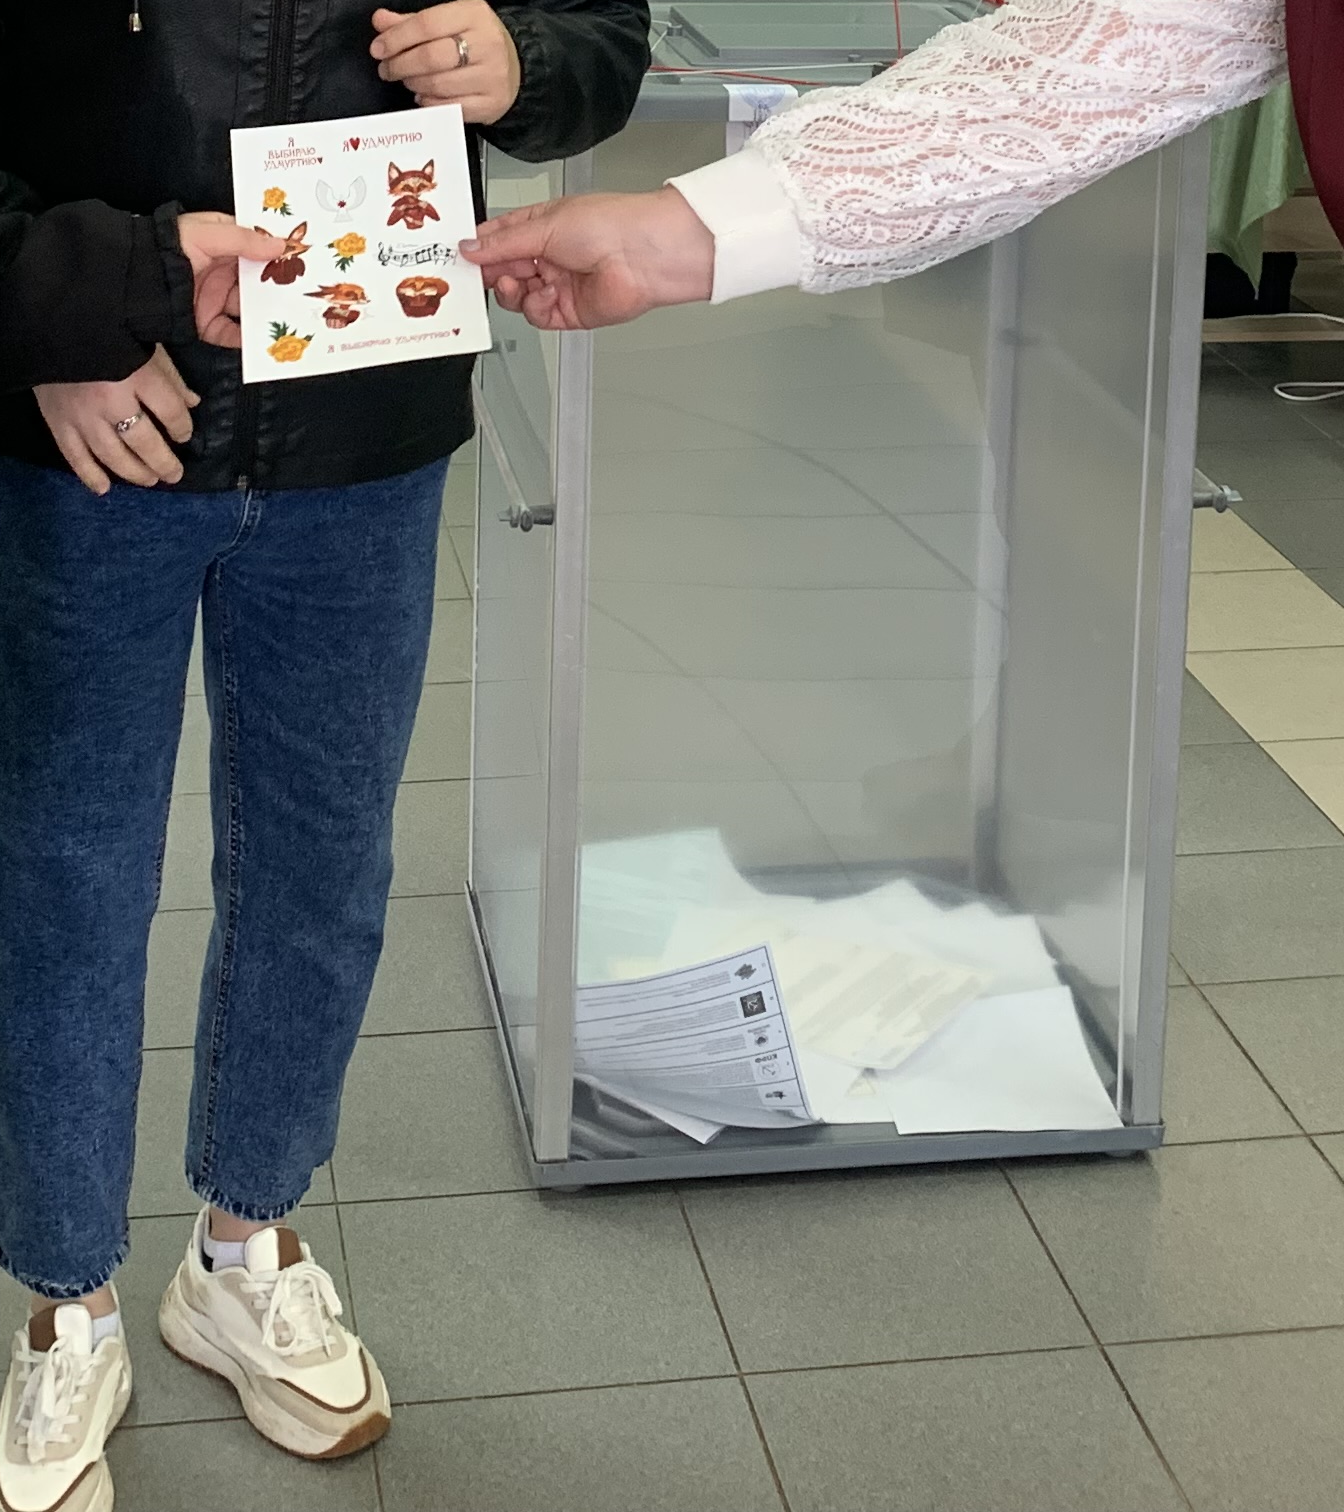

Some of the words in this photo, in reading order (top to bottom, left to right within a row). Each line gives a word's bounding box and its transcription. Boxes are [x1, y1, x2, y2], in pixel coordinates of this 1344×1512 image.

[288, 136, 294, 147] Я
[342, 140, 349, 152] Я
[362, 132, 422, 150] УДМУРТИЮ
[268, 147, 316, 159] ВЫБИРАЮ
